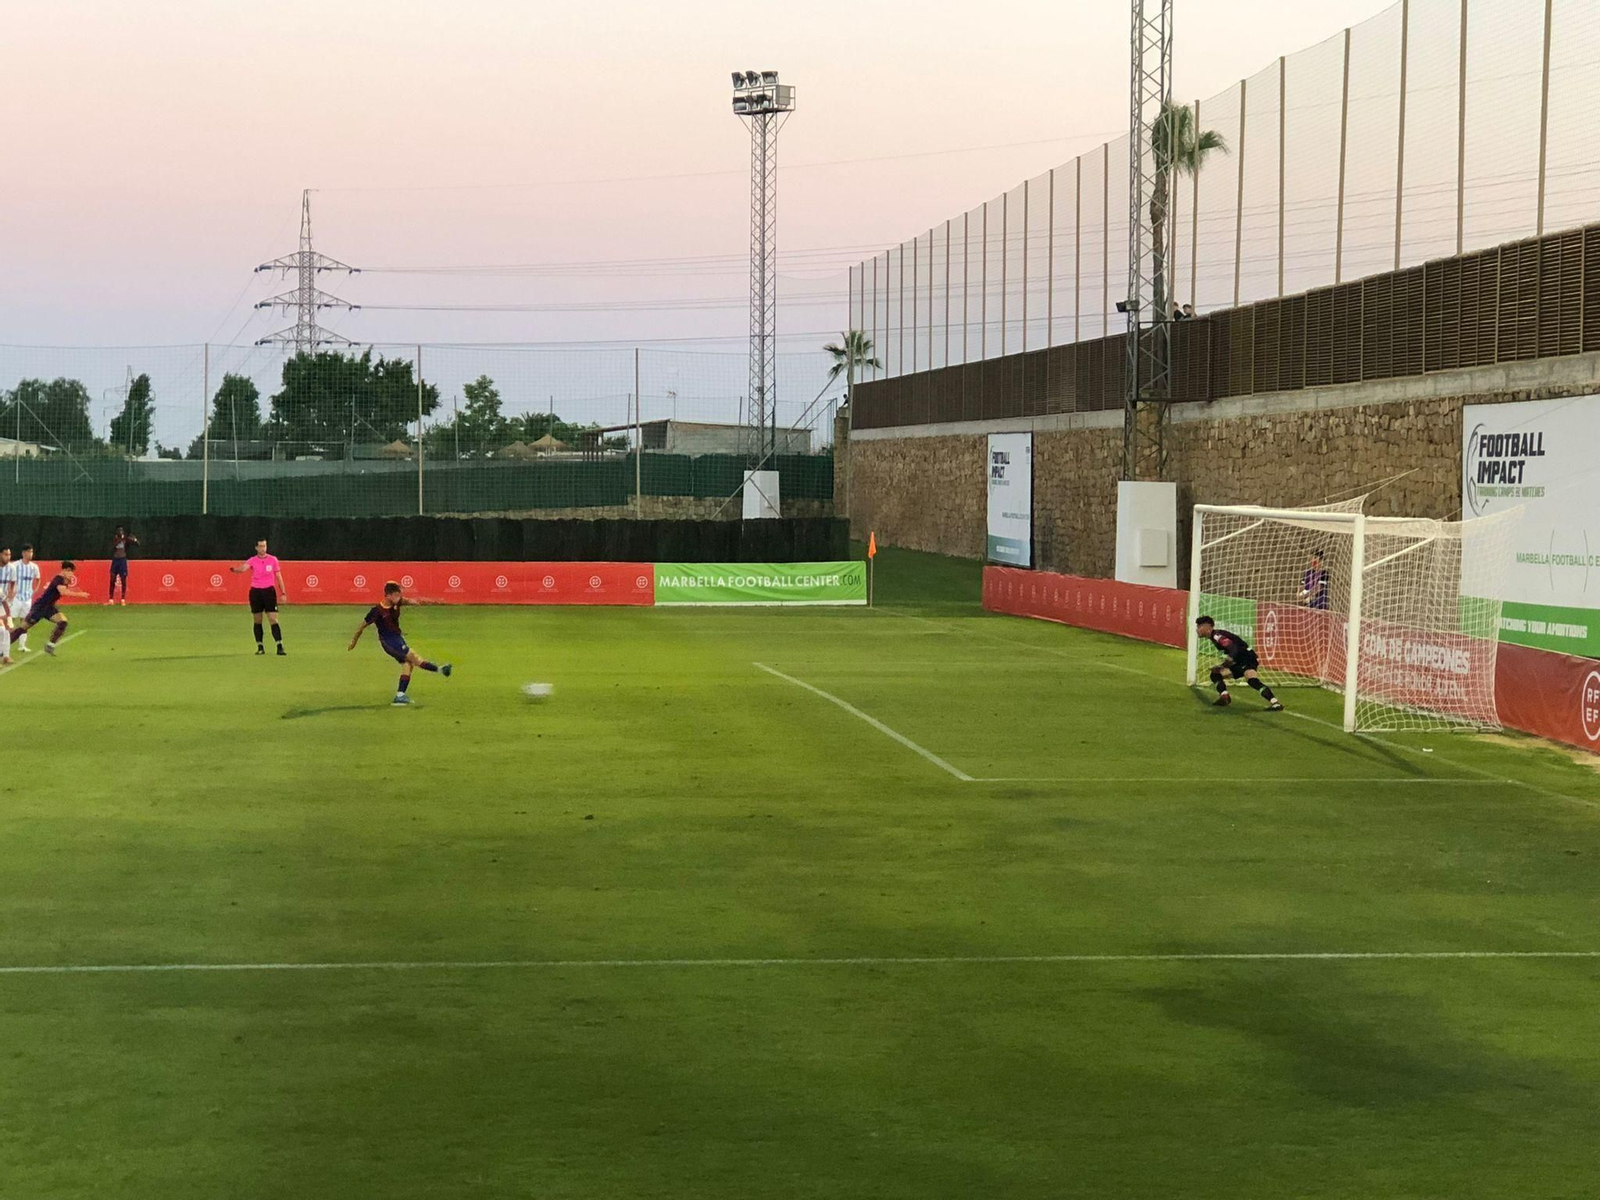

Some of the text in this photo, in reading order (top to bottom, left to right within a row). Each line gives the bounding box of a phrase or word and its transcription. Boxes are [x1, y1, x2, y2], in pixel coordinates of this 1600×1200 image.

[1479, 432, 1545, 457] FOOTBALL
[1477, 460, 1525, 484] IMPACT
[1516, 552, 1549, 565] MARBELLA
[1551, 554, 1586, 567] FOOTBALL
[659, 575, 726, 587] MARBELLA
[728, 575, 793, 587] FOOTBALL
[1405, 641, 1470, 674] CAMPEONES
